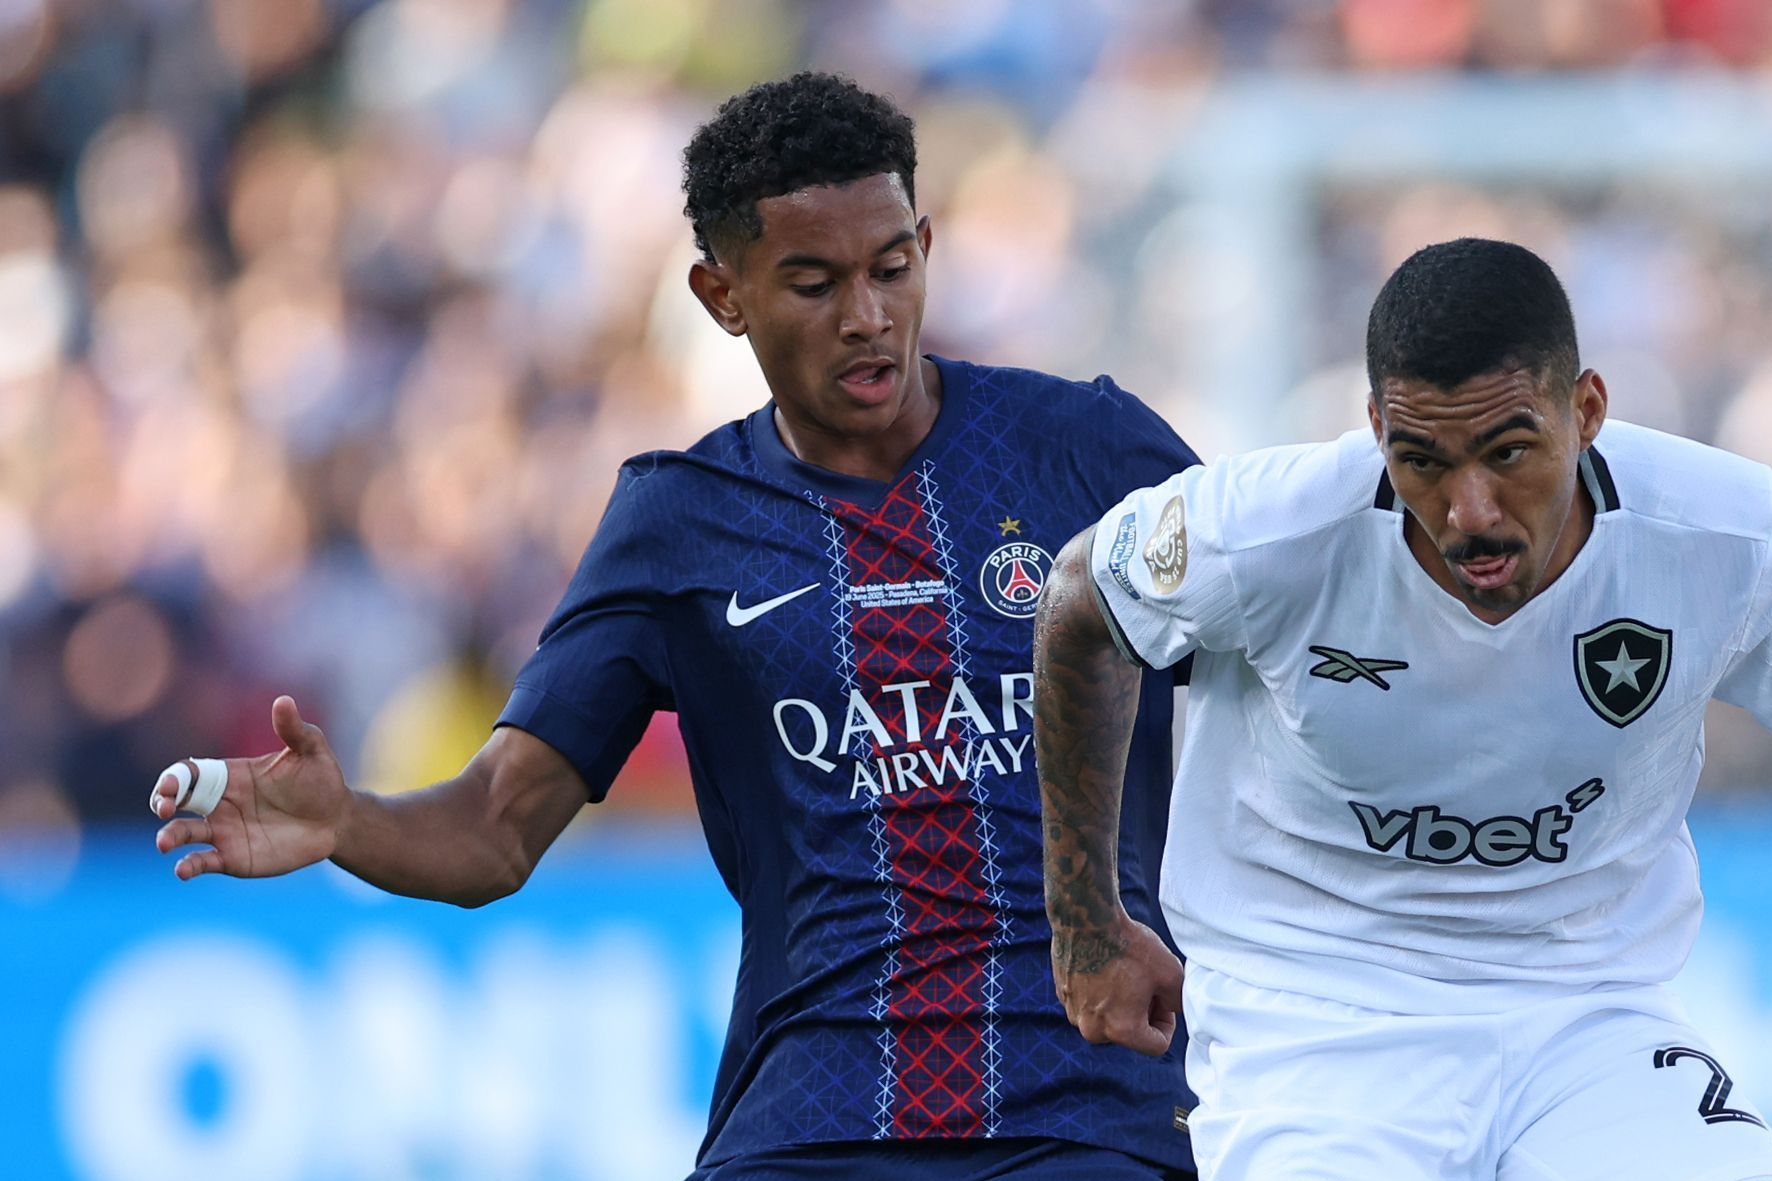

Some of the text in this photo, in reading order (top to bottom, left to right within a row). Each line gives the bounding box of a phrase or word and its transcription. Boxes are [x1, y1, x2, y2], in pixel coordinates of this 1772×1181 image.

[990, 546, 1042, 568] PARIS
[998, 600, 1018, 612] SAINT
[773, 672, 1034, 774] QATAR
[849, 734, 1038, 800] AIRWAY
[1348, 800, 1574, 867] vbet
